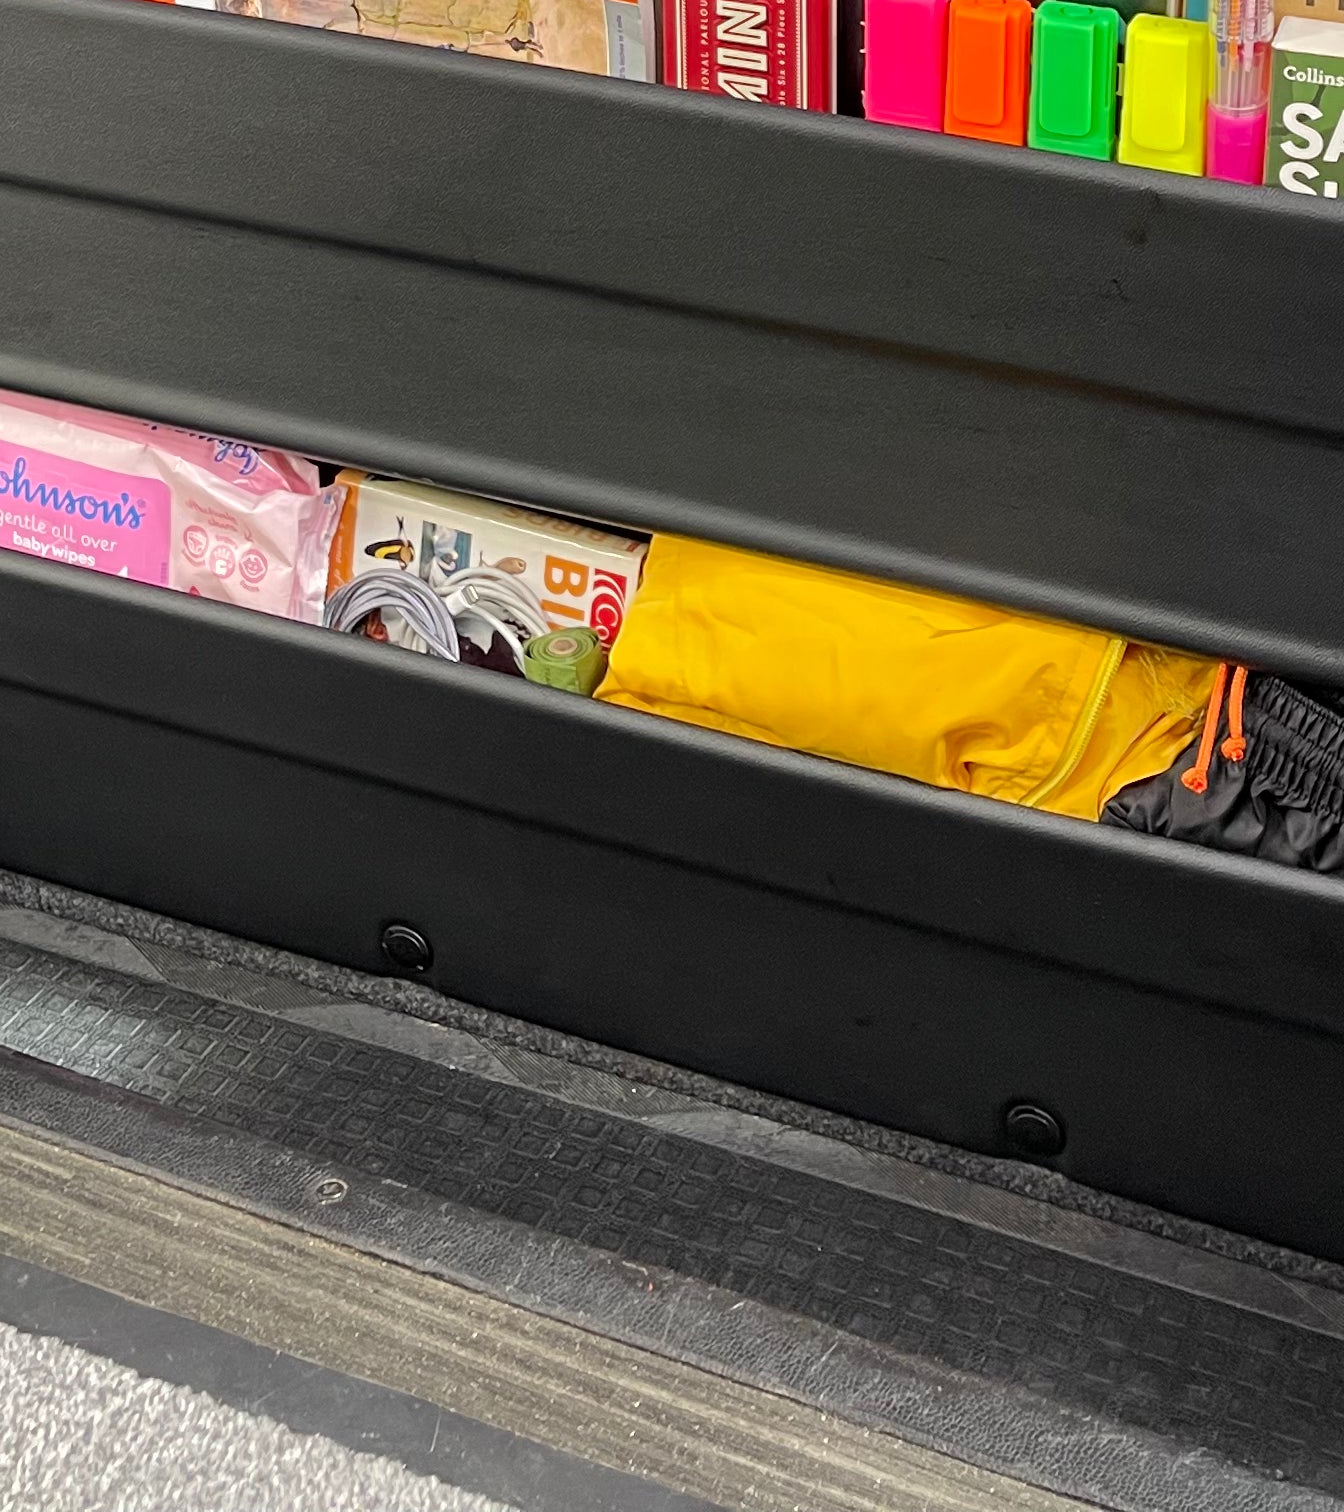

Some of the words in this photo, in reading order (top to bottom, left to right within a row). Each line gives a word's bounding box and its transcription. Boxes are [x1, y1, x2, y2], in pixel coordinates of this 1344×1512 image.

[776, 10, 786, 38] Piece
[777, 43, 786, 55] 28
[778, 69, 786, 85] Six
[1283, 65, 1344, 88] Collins
[51, 524, 77, 544] all
[80, 534, 118, 553] over
